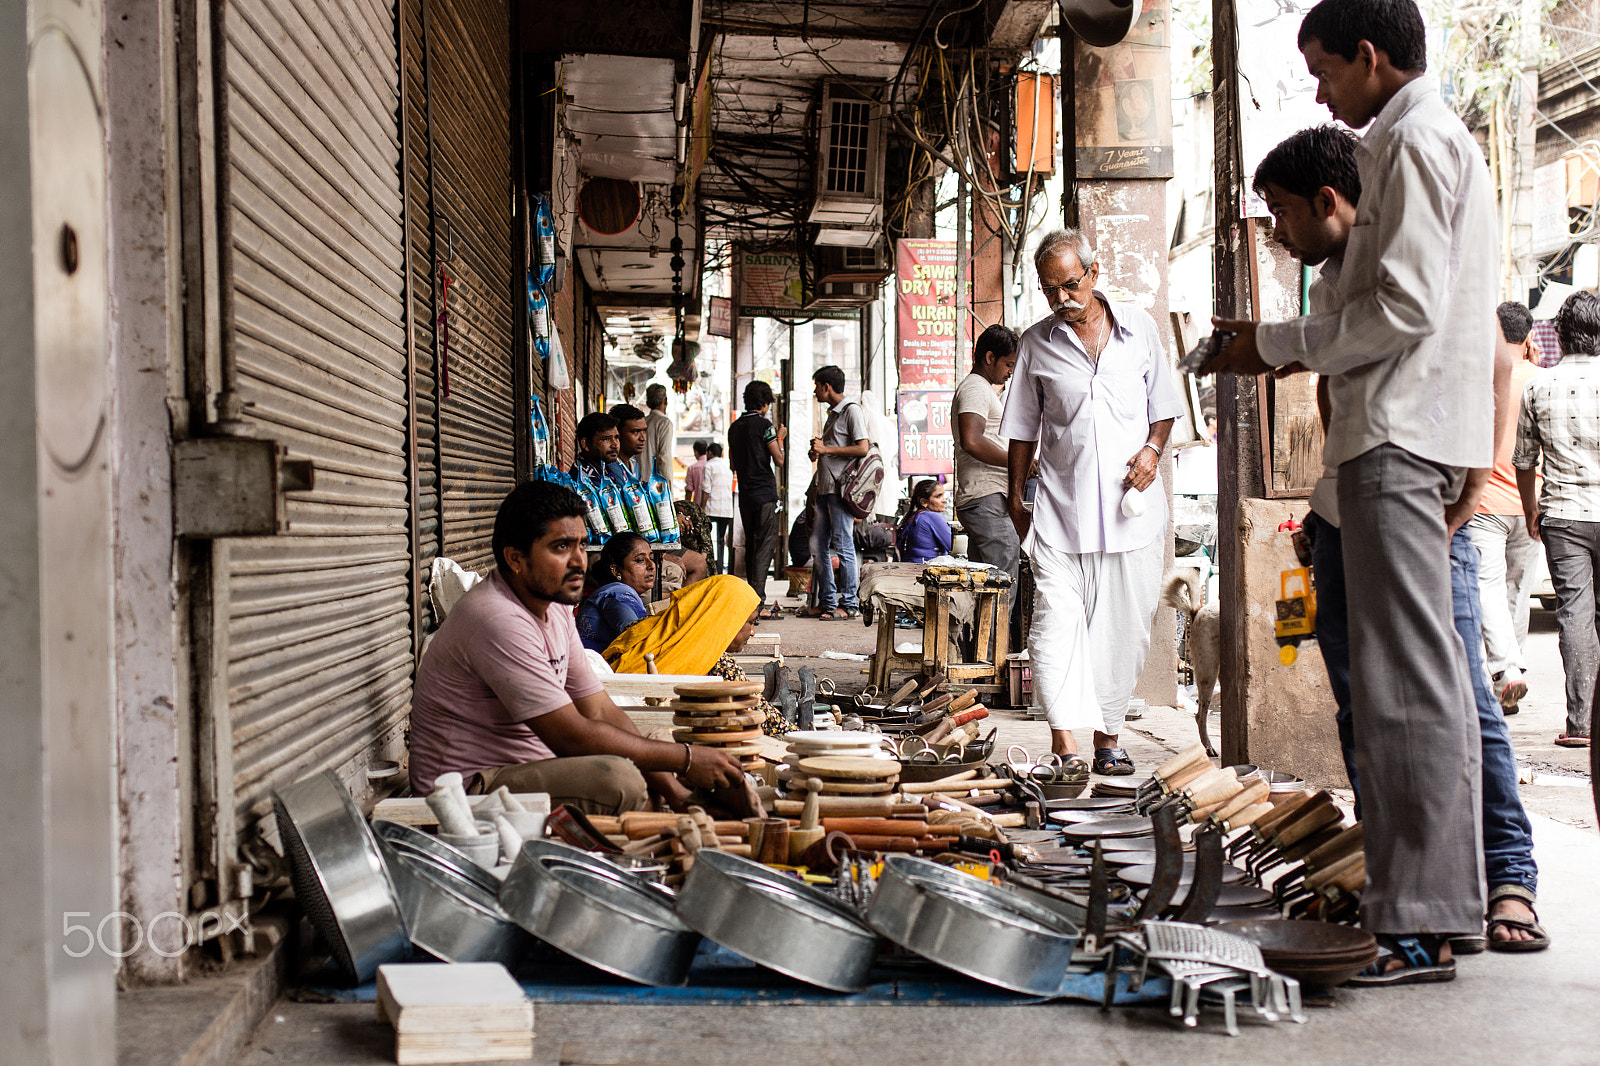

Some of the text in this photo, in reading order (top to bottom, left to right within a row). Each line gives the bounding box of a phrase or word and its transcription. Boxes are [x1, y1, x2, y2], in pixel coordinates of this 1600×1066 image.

[1104, 148, 1144, 163] 7 Years
[745, 255, 789, 266] SAHNI
[912, 263, 957, 280] SAWA
[902, 279, 972, 297] DRY FRT
[745, 307, 793, 317] Contiental
[912, 305, 968, 321] KIRAN
[917, 320, 957, 337] STOR
[903, 339, 919, 347] Deals
[916, 348, 941, 358] Marriage
[923, 366, 928, 374] &
[903, 424, 922, 460] की
